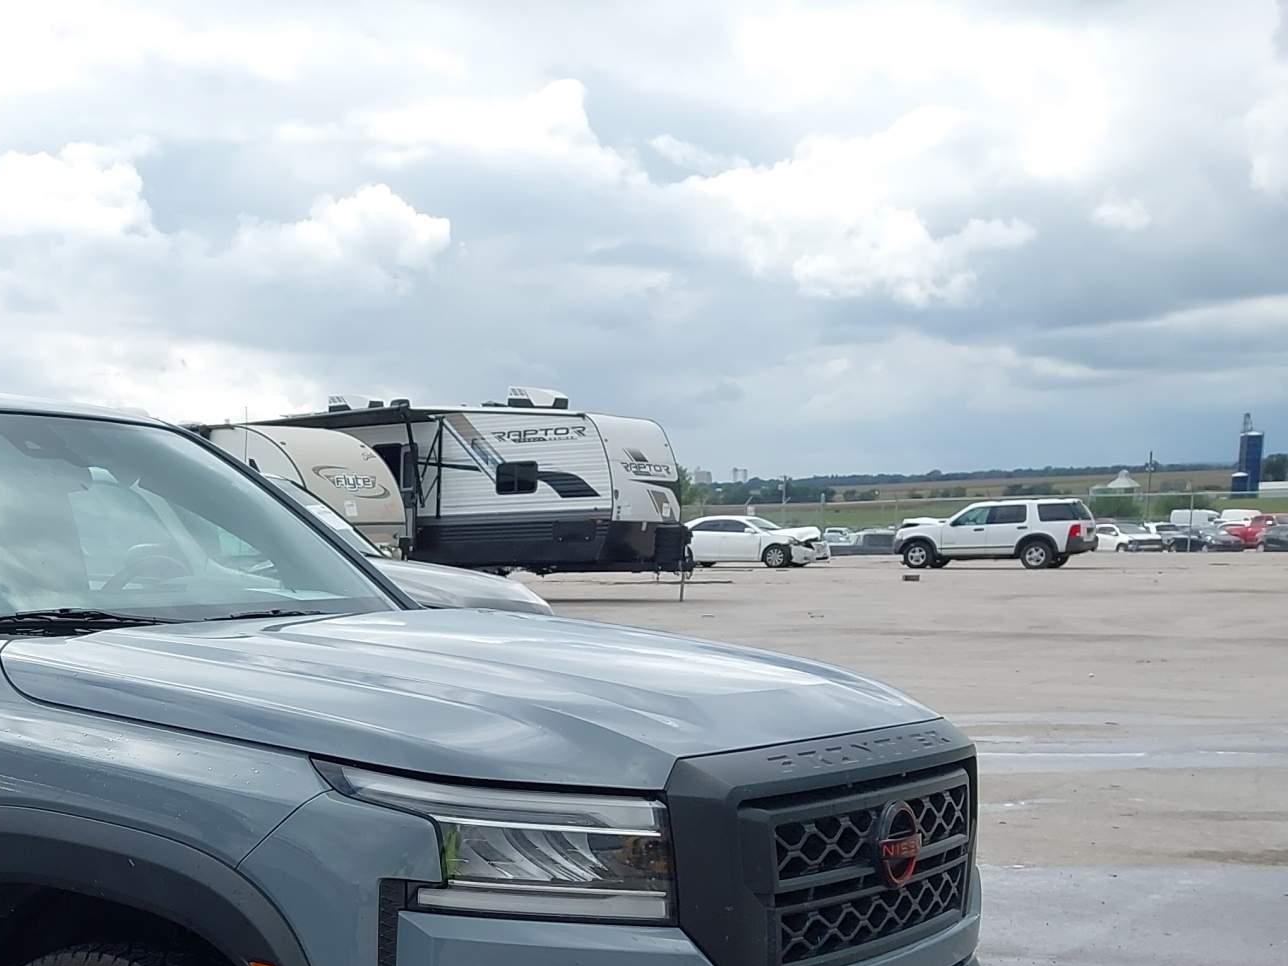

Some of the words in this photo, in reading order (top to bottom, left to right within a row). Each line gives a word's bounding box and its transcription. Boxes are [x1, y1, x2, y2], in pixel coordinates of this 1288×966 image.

[490, 425, 587, 442] RAPTOR
[620, 461, 671, 475] RAPTOR
[766, 730, 952, 774] FRONTIER
[881, 838, 920, 858] NISS
